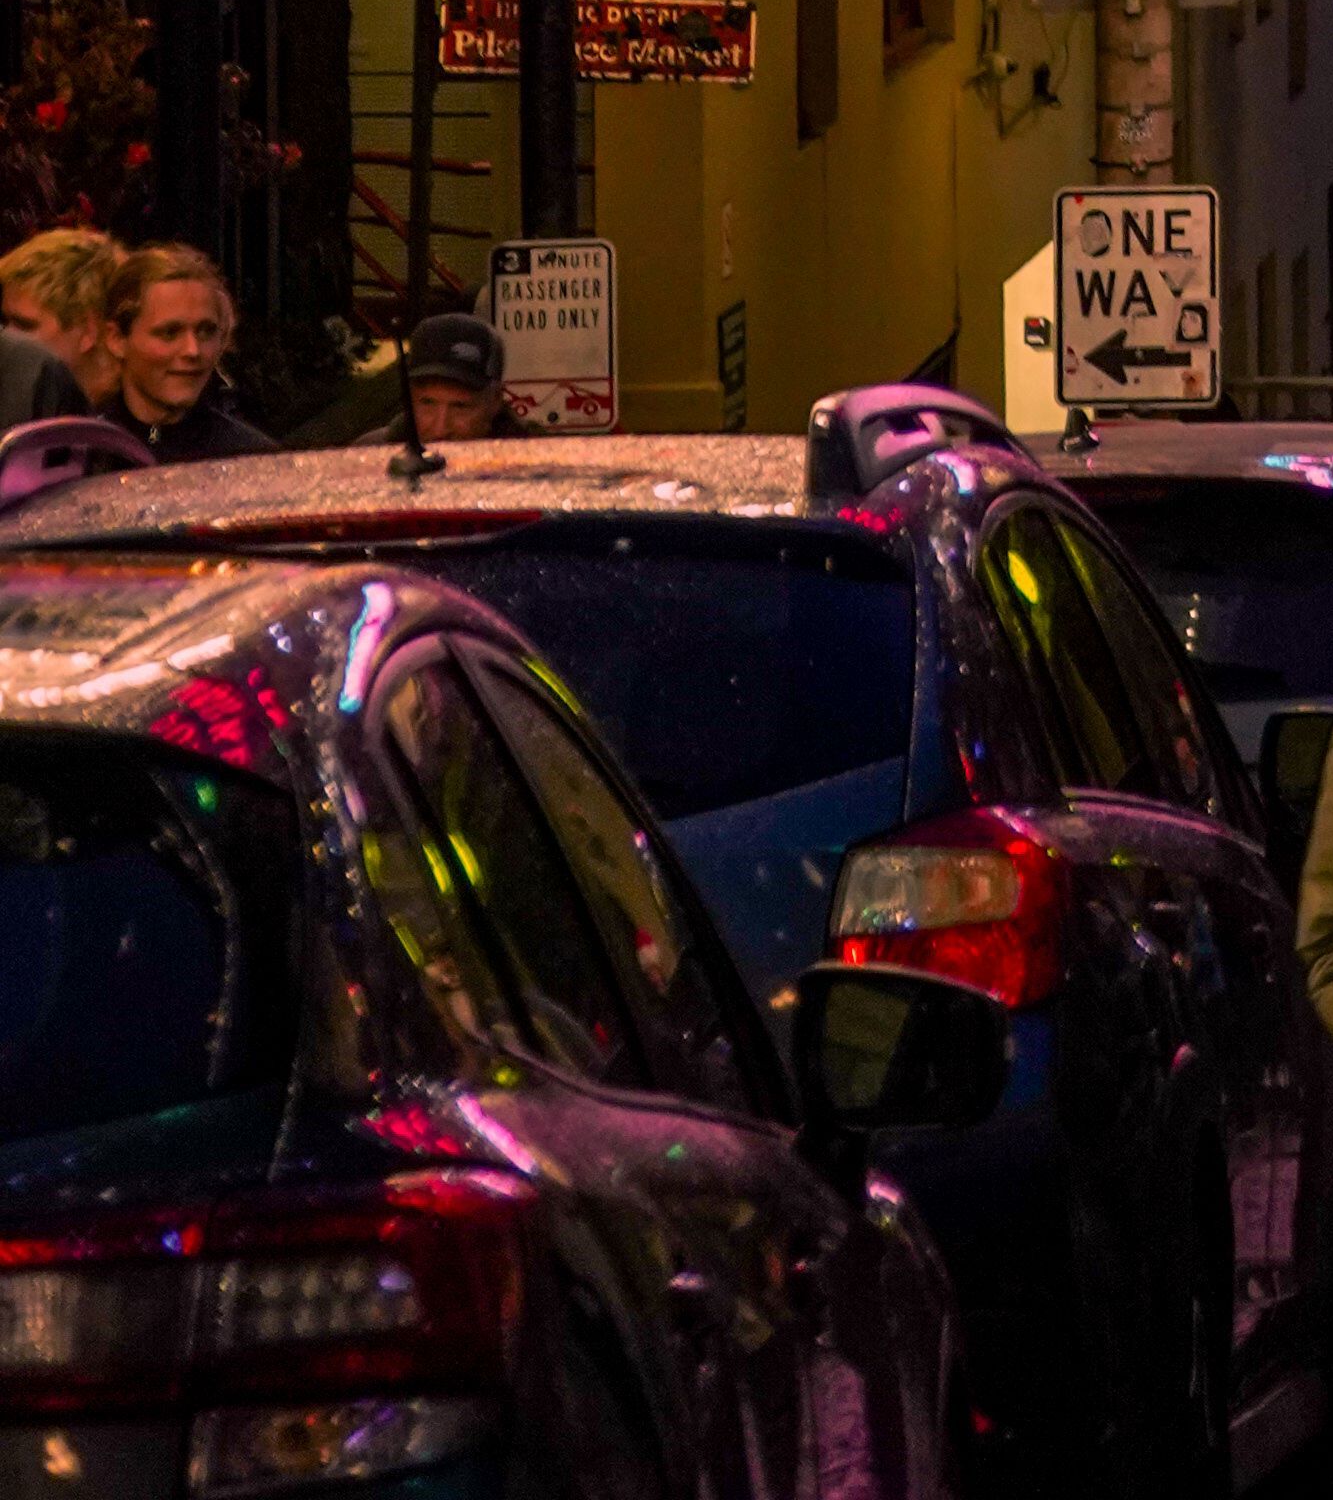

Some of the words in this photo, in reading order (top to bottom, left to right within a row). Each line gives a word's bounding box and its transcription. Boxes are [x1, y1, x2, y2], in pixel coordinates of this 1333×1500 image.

[1080, 208, 1193, 257] ONE
[1076, 268, 1195, 318] WAY
[503, 309, 547, 332] LOAD
[558, 307, 600, 329] ONLY
